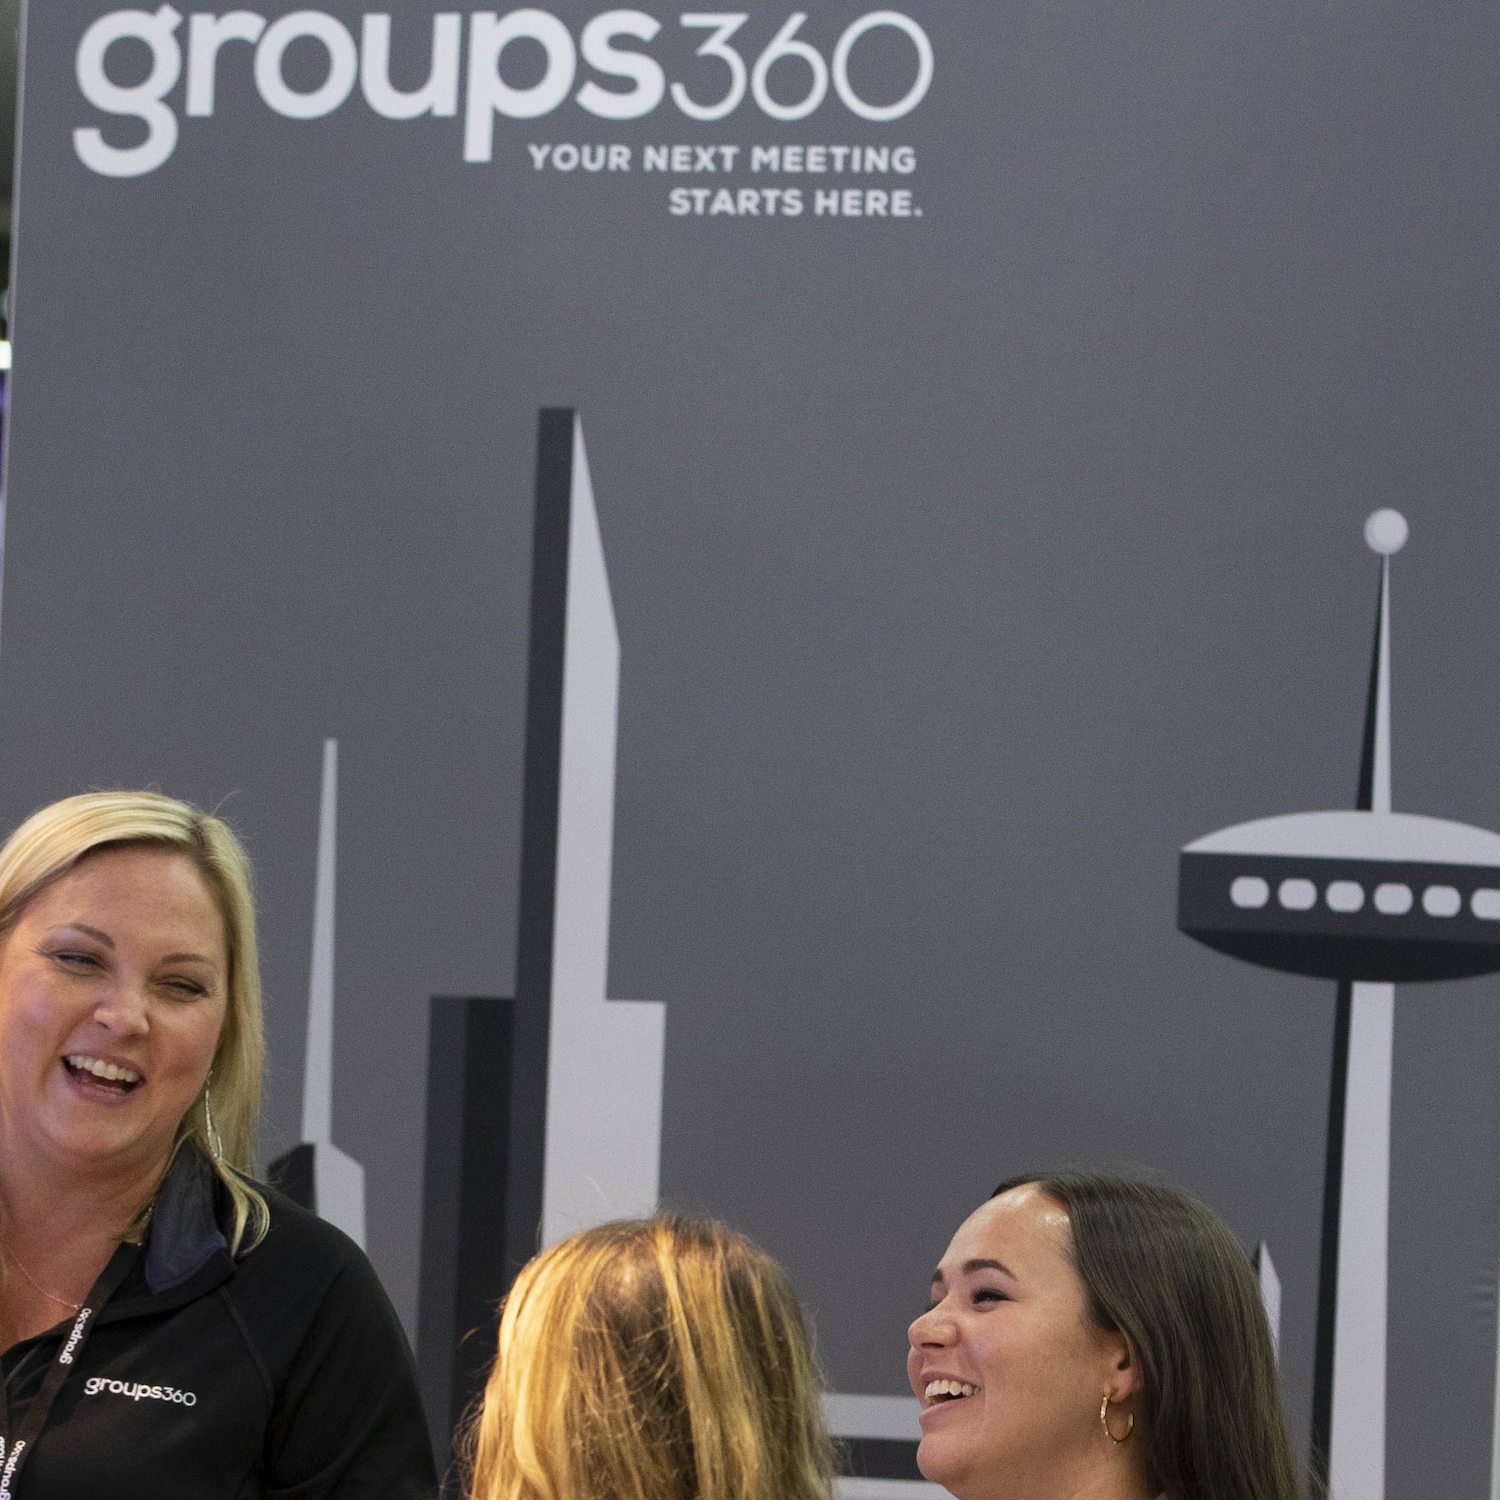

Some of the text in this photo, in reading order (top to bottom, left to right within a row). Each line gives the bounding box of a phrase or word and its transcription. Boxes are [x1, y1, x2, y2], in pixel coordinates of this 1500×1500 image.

[73, 3, 935, 177] groups360
[528, 144, 916, 174] YOUR NEXT MEETING
[668, 188, 924, 218] STARTS HERE.
[59, 1307, 92, 1365] groups360
[84, 1377, 197, 1406] groups360
